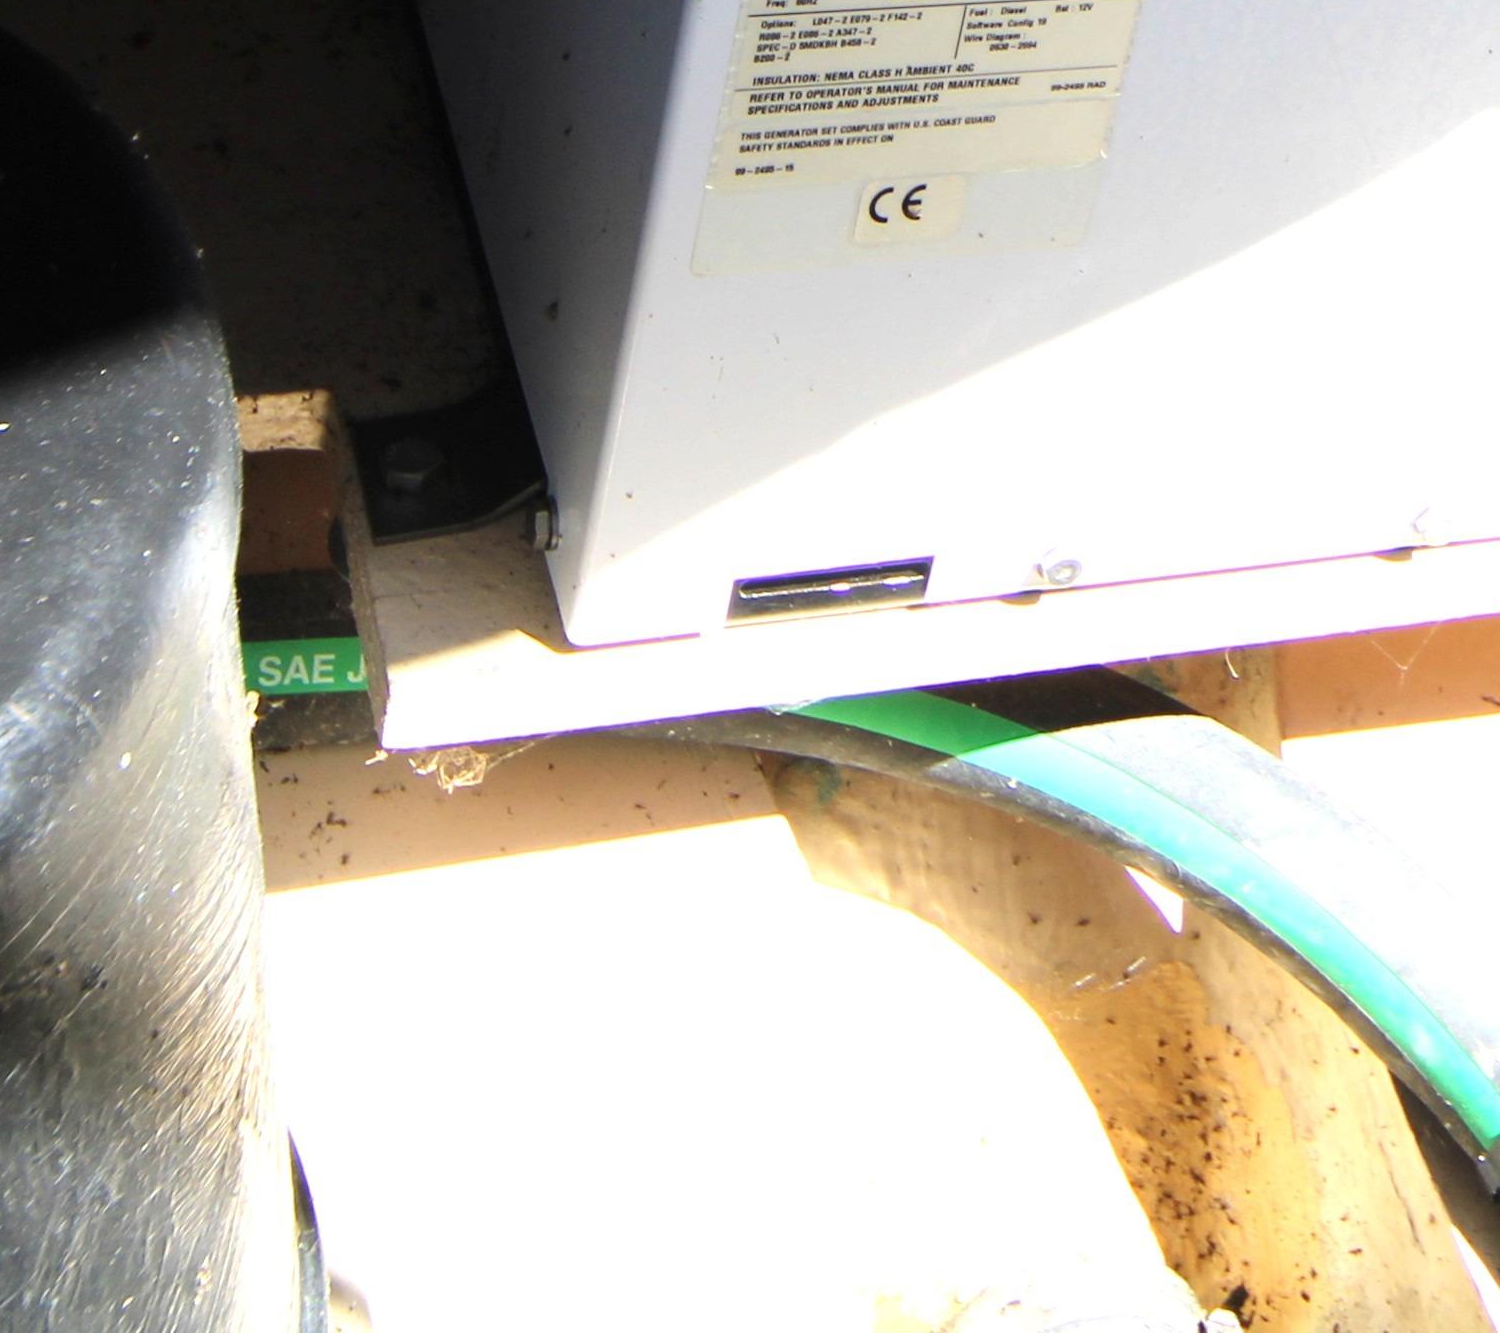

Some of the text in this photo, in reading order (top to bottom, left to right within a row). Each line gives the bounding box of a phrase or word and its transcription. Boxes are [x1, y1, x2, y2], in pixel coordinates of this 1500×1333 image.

[752, 63, 974, 85] INSULATION: NEMA CLASS H AMBIENT 40C
[749, 76, 1019, 102] REFER TO OPERATOR'S MANUAL FOR MAINTENANCE
[747, 93, 938, 115] SPECIFICATIONS AND ADJUSTMENTS
[741, 131, 761, 140] THIS
[763, 127, 818, 139] GENERATOR
[821, 126, 837, 135] SET
[839, 123, 884, 133] COMPLIES
[887, 121, 910, 130] WITH
[933, 117, 961, 126] COAST
[964, 115, 995, 124] GUARD
[739, 142, 773, 153] SAFETY
[776, 138, 830, 150] STANDARDS
[846, 135, 877, 145] EFFECT
[880, 134, 893, 142] ON
[258, 654, 336, 687] SAE
